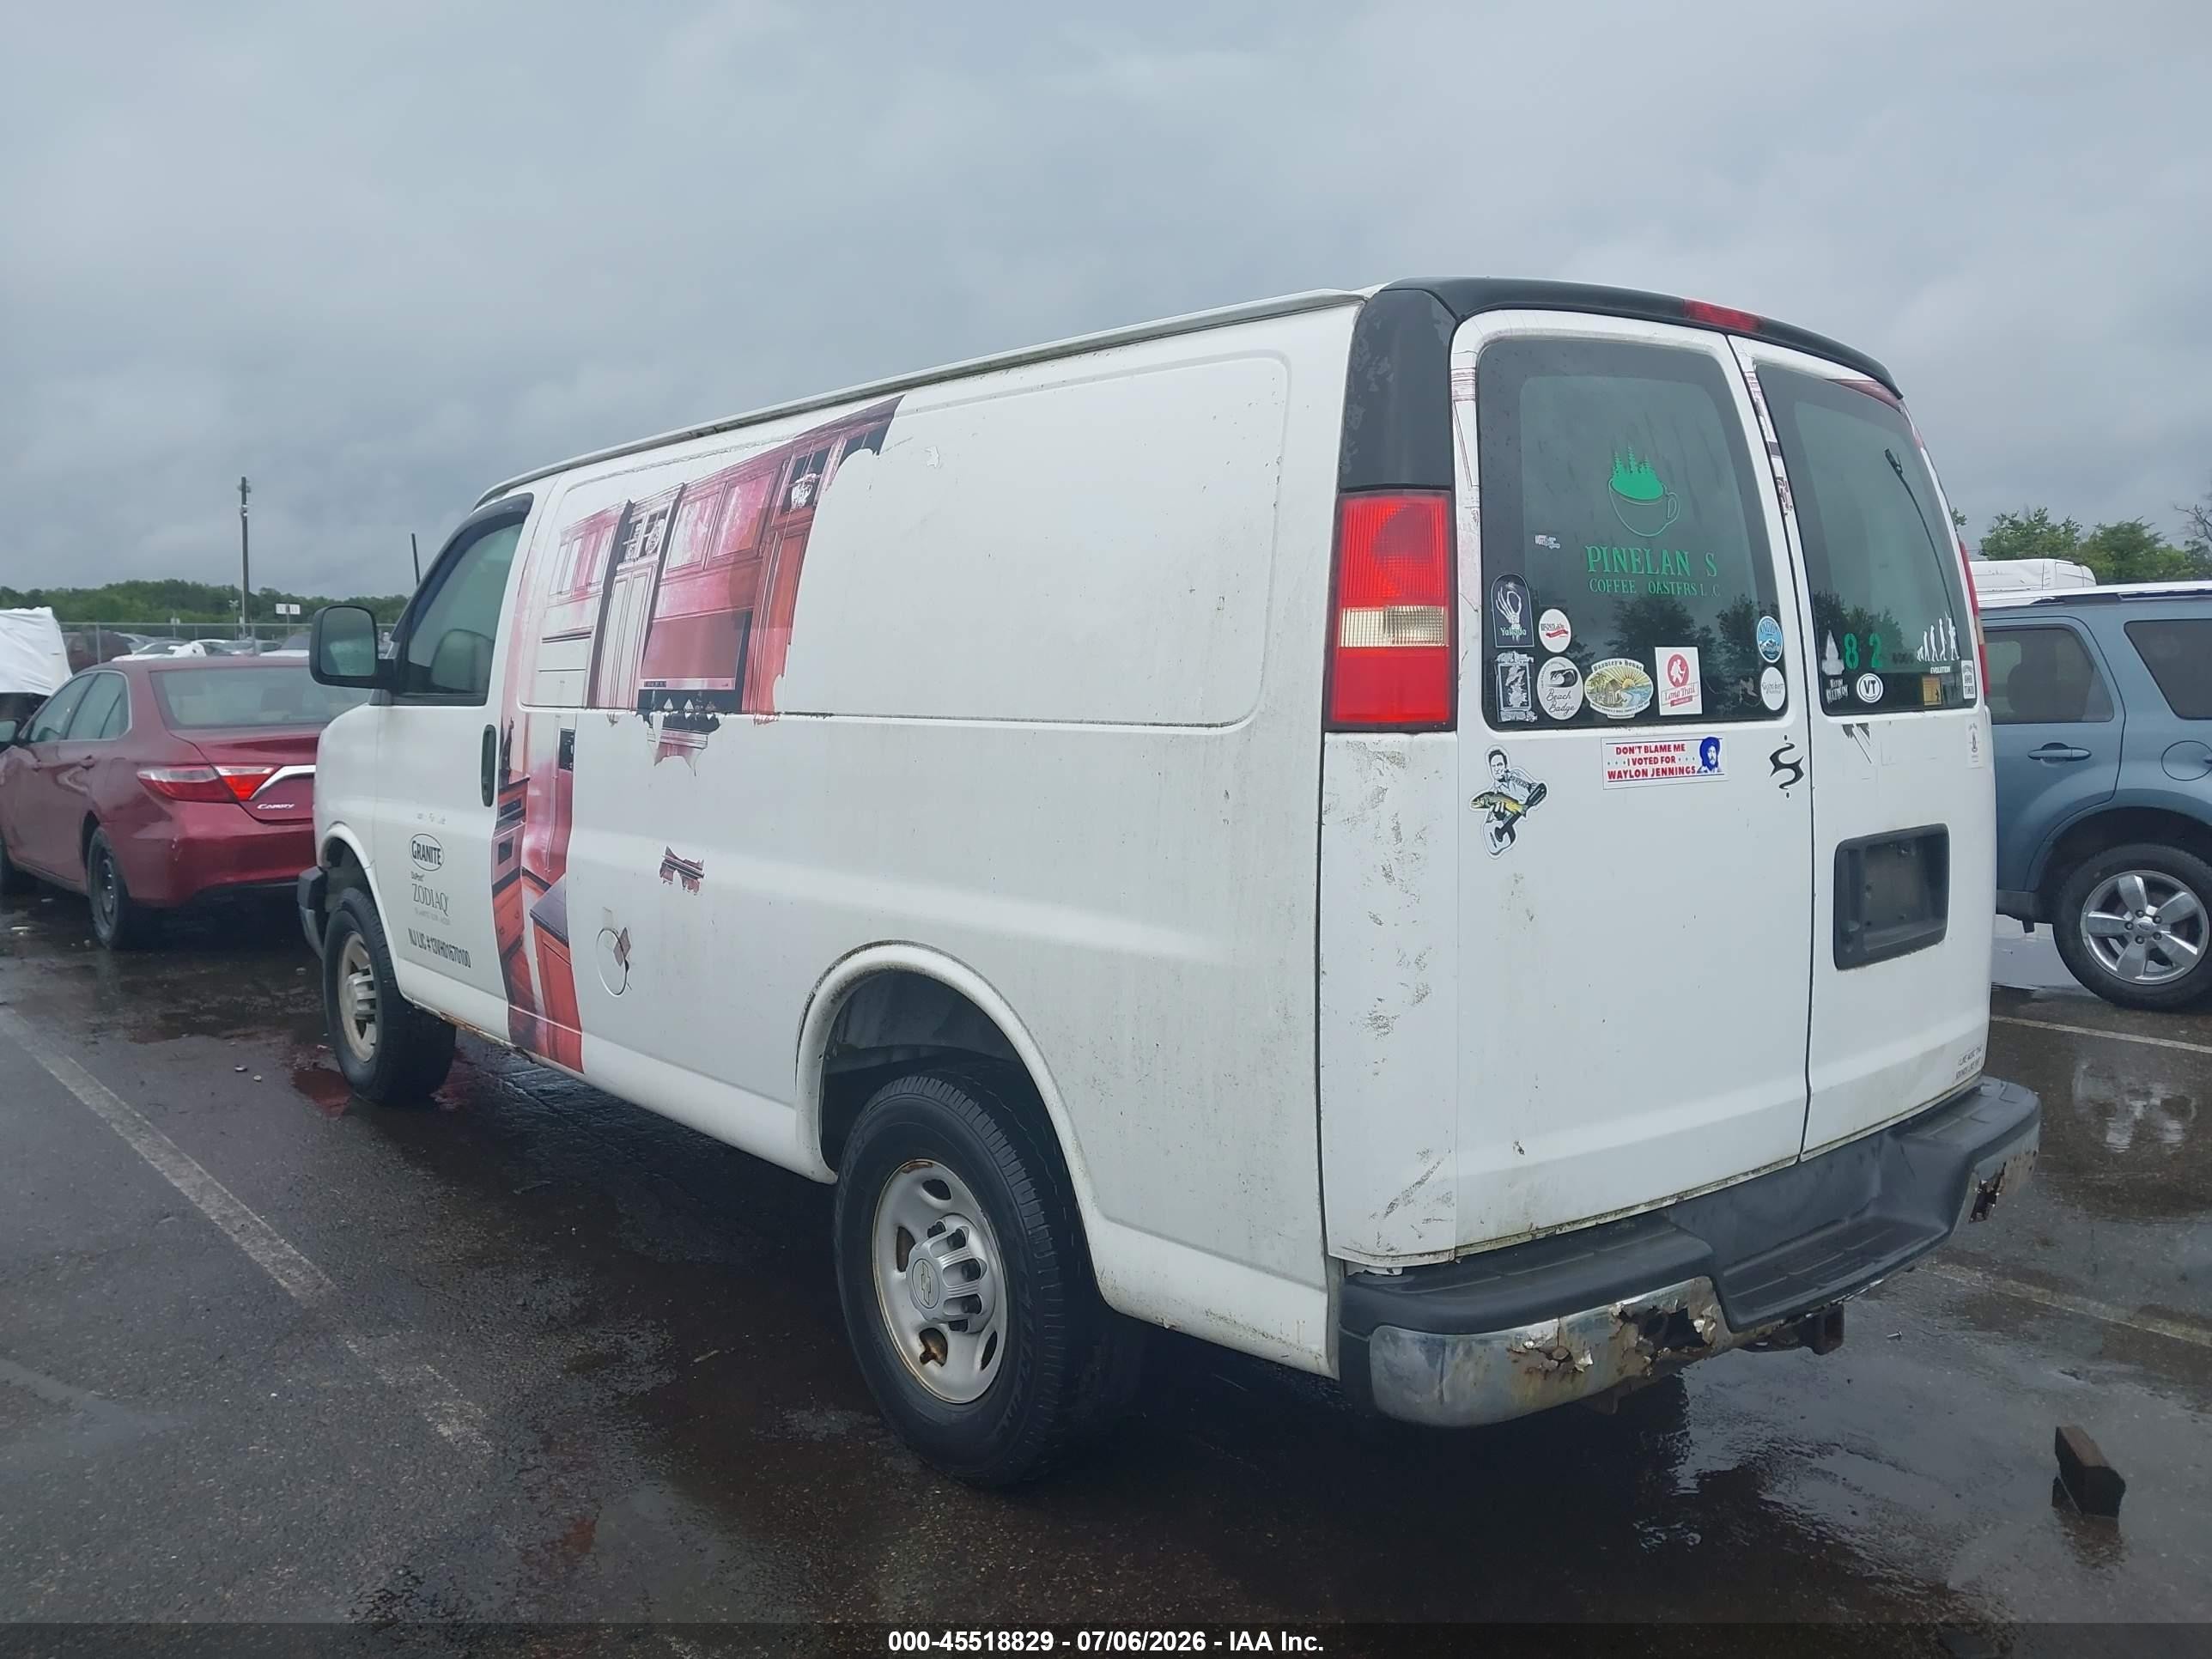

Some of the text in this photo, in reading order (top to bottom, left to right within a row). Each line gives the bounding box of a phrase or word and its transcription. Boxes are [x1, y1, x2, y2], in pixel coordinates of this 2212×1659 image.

[1589, 579, 1637, 593] COFFEE
[1863, 679, 1876, 695] VT
[1547, 688, 1571, 702] Beach
[1549, 700, 1575, 716] Badge
[1615, 744, 1686, 756] DON'T BLAME ME
[1632, 757, 1659, 766] VOTED
[1661, 756, 1676, 764] FOR
[1607, 765, 1696, 780] WAYLON JENNINGS
[412, 841, 441, 866] GRANITE
